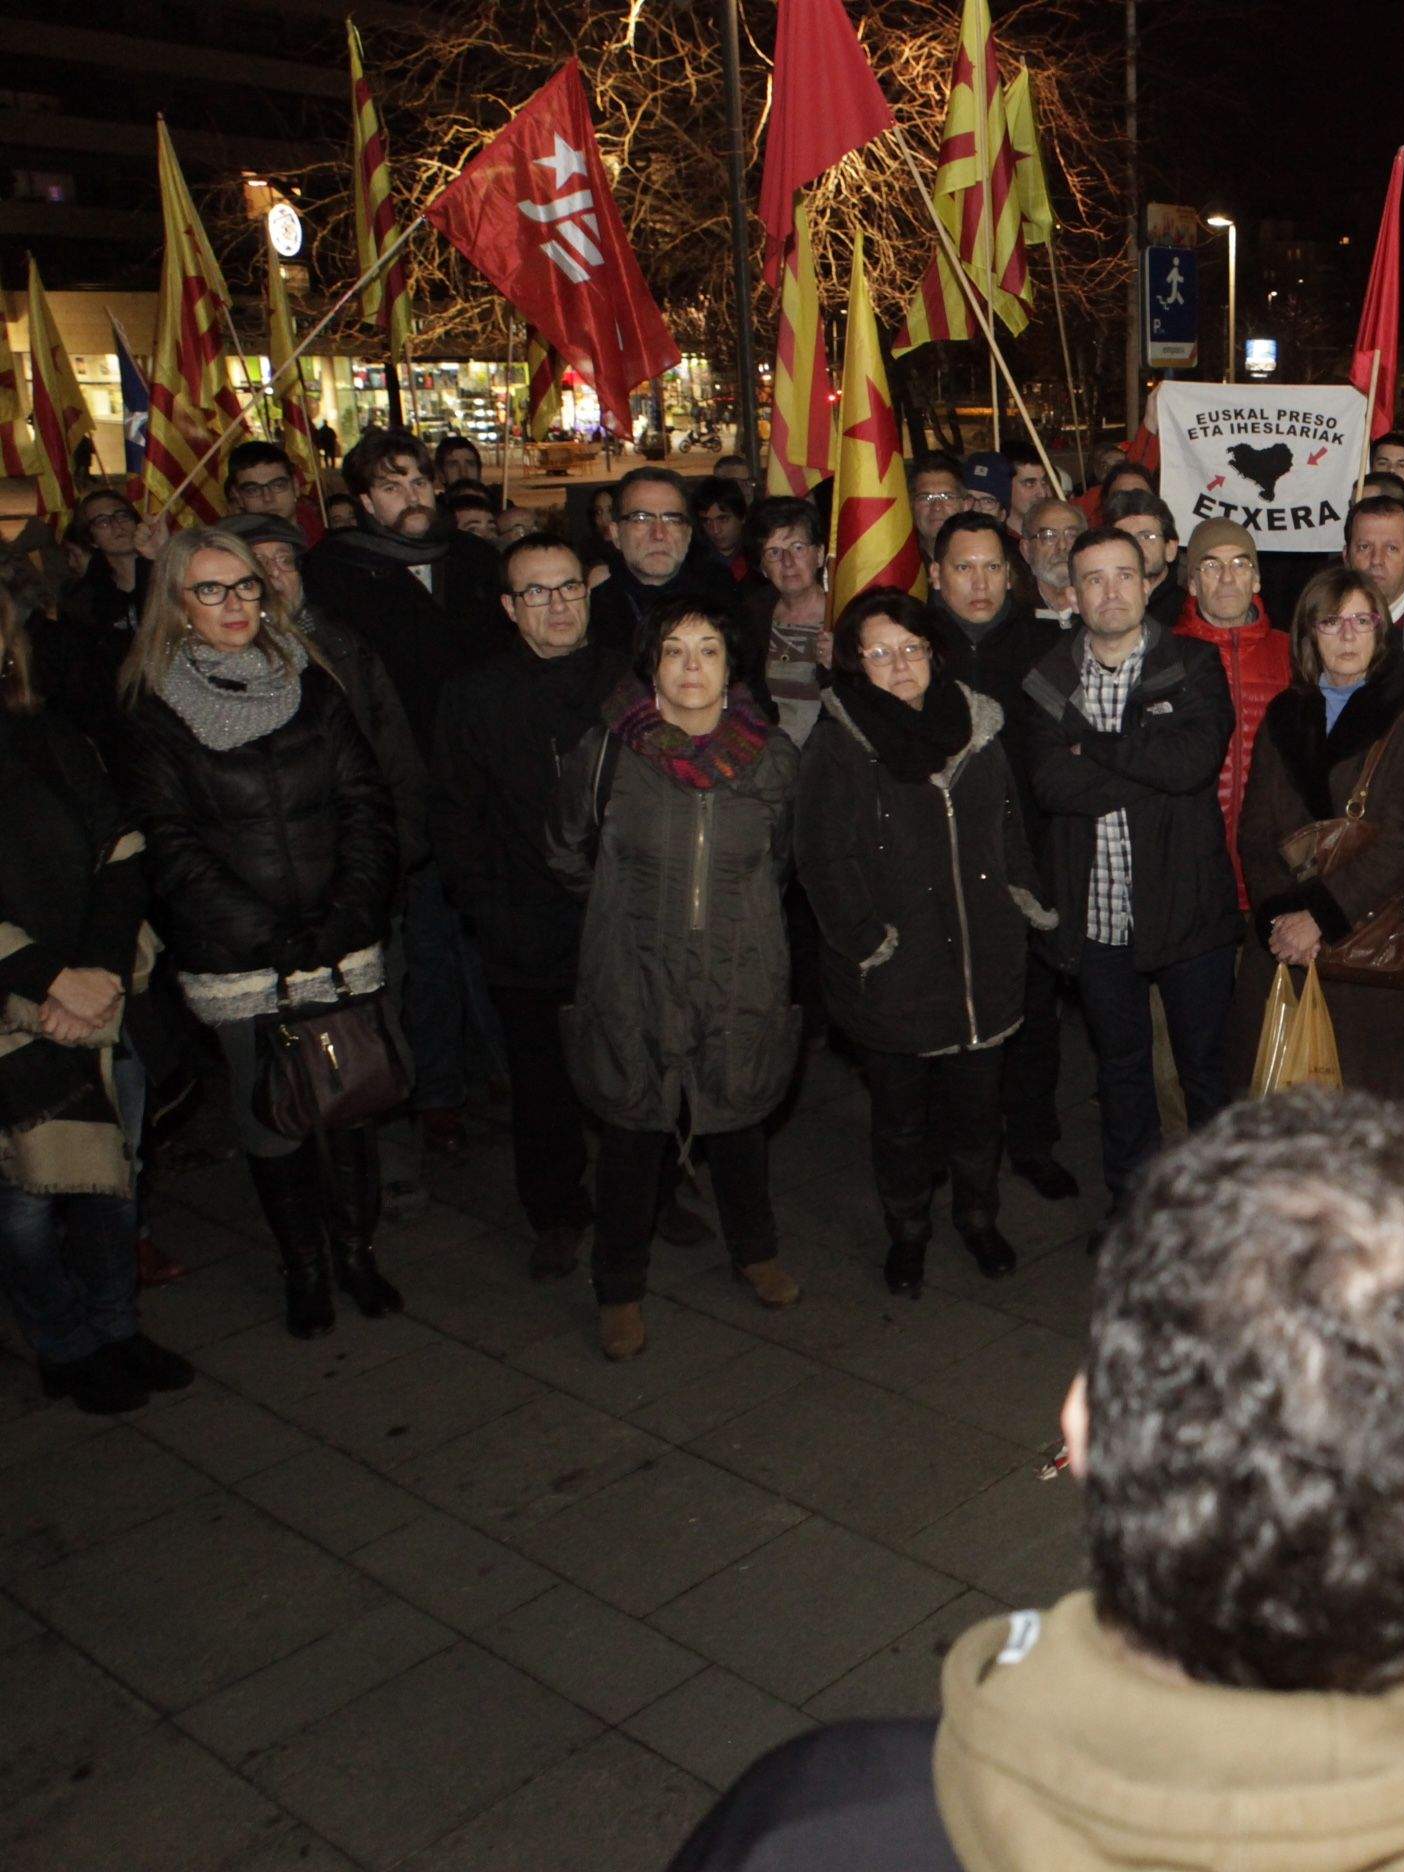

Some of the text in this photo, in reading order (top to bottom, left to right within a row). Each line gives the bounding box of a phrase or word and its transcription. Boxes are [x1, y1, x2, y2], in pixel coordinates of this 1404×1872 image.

[1196, 408, 1338, 429] EUSKAL PRESO
[1188, 423, 1345, 445] ETA IHESLARIAK
[1193, 493, 1341, 532] ETXERA
